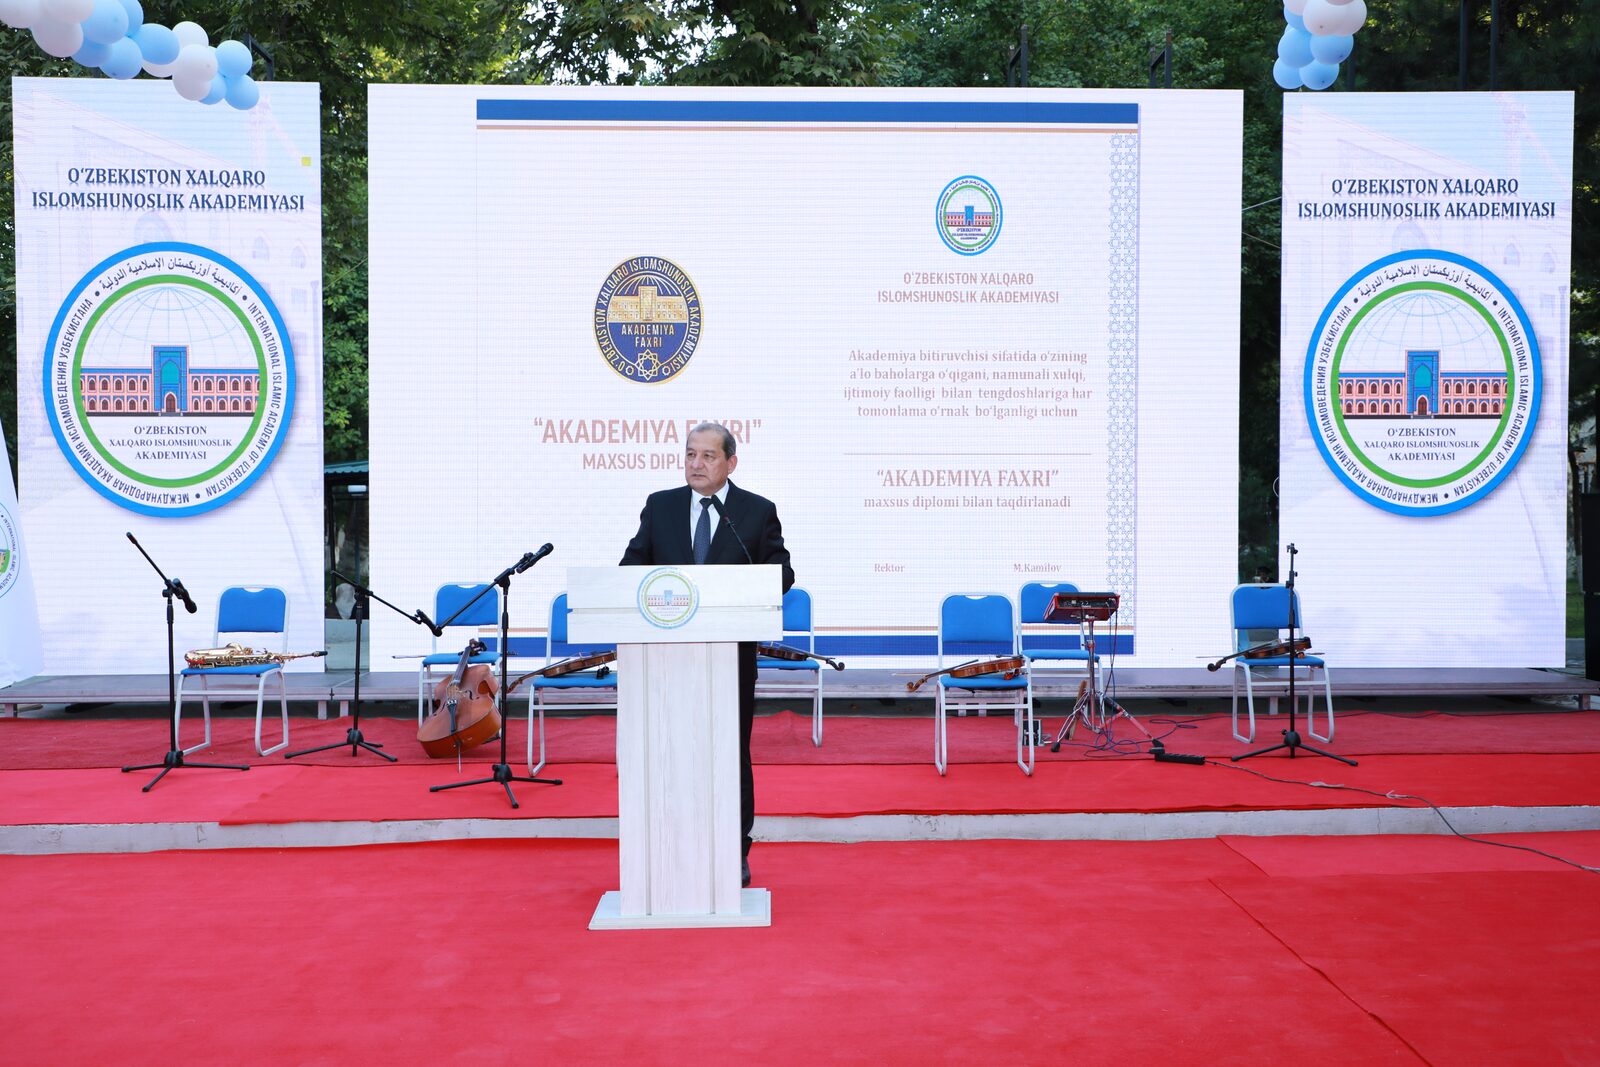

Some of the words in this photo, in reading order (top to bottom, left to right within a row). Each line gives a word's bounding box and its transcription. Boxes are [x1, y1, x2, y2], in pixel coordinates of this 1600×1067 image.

[186, 169, 265, 187] XALQARO
[1442, 179, 1519, 196] XALQARO
[32, 192, 184, 208] ISLOMSHUNOSLIK
[189, 193, 305, 209] AKADEMIYASI
[1299, 202, 1441, 218] ISLOMSHUNOSLIK
[1444, 202, 1556, 217] AKADEMIYASI
[980, 272, 1034, 287] XALQARO
[877, 290, 977, 304] ISLOMSHUNOSLIK
[980, 290, 1059, 304] AKADEMIYASI
[598, 265, 629, 307] XALQARO
[629, 258, 697, 304] ISLOMSHUNOSLIK
[672, 307, 700, 372] AKADEMIYASI
[59, 299, 94, 359] УЗБЕКИСТАНА
[248, 302, 281, 369] INTERNATIONAL
[621, 324, 675, 335] AKADEMIYA
[1319, 305, 1352, 364] УЗБЕКИСТАНА
[635, 337, 662, 348] FAXRI
[1497, 308, 1528, 372] INTERNATIONAL
[848, 350, 916, 364] Akademiya
[919, 350, 989, 362] bitiruvchisi
[992, 350, 1037, 362] sifatida
[874, 368, 936, 383] baholarga
[992, 368, 1050, 380] namunali
[1052, 368, 1086, 383] xulqi,
[271, 372, 282, 409] ISLAMIC
[843, 387, 890, 402] ijtimoiy
[893, 387, 936, 402] faolligi
[942, 387, 972, 399] bilan
[978, 387, 1069, 402] tengdoshlariga
[1072, 387, 1093, 399] har
[1517, 375, 1529, 411] ISLAMIC
[57, 361, 80, 442] ИСЛАМОВЕДЕНИЯ
[1317, 366, 1337, 444] ИСЛАМОВЕДЕНИЯ
[857, 405, 927, 417] tomonlama
[1041, 405, 1078, 417] uchun
[256, 411, 278, 452] ACADEMY
[1502, 413, 1524, 453] ACADEMY
[110, 439, 152, 448] XALQARO
[155, 439, 232, 447] ISLOMSHUNOSLIK
[1364, 441, 1404, 449] XALQARO
[76, 441, 113, 483] АКАДЕМИЯ
[135, 451, 207, 460] AKADEMIYASI
[248, 450, 260, 464] OF
[583, 453, 646, 470] MAXSUS
[651, 453, 685, 470] DIPL
[1332, 444, 1367, 483] АКАДЕМИЯ
[1388, 452, 1455, 461] AKADEMIYASI
[1495, 451, 1505, 465] OF
[205, 461, 251, 497] UZBEKISTAN
[1453, 461, 1497, 497] UZBEKISTAN
[113, 478, 190, 504] МЕЖДУНАРОДНАЯ
[1367, 478, 1438, 504] МЕЖДУНАРОДНАЯ
[864, 498, 909, 508] maxsus
[912, 496, 959, 510] diplomi
[963, 496, 993, 508] bilan
[996, 496, 1071, 510] taqdirlanadi
[874, 562, 905, 573] Rektor
